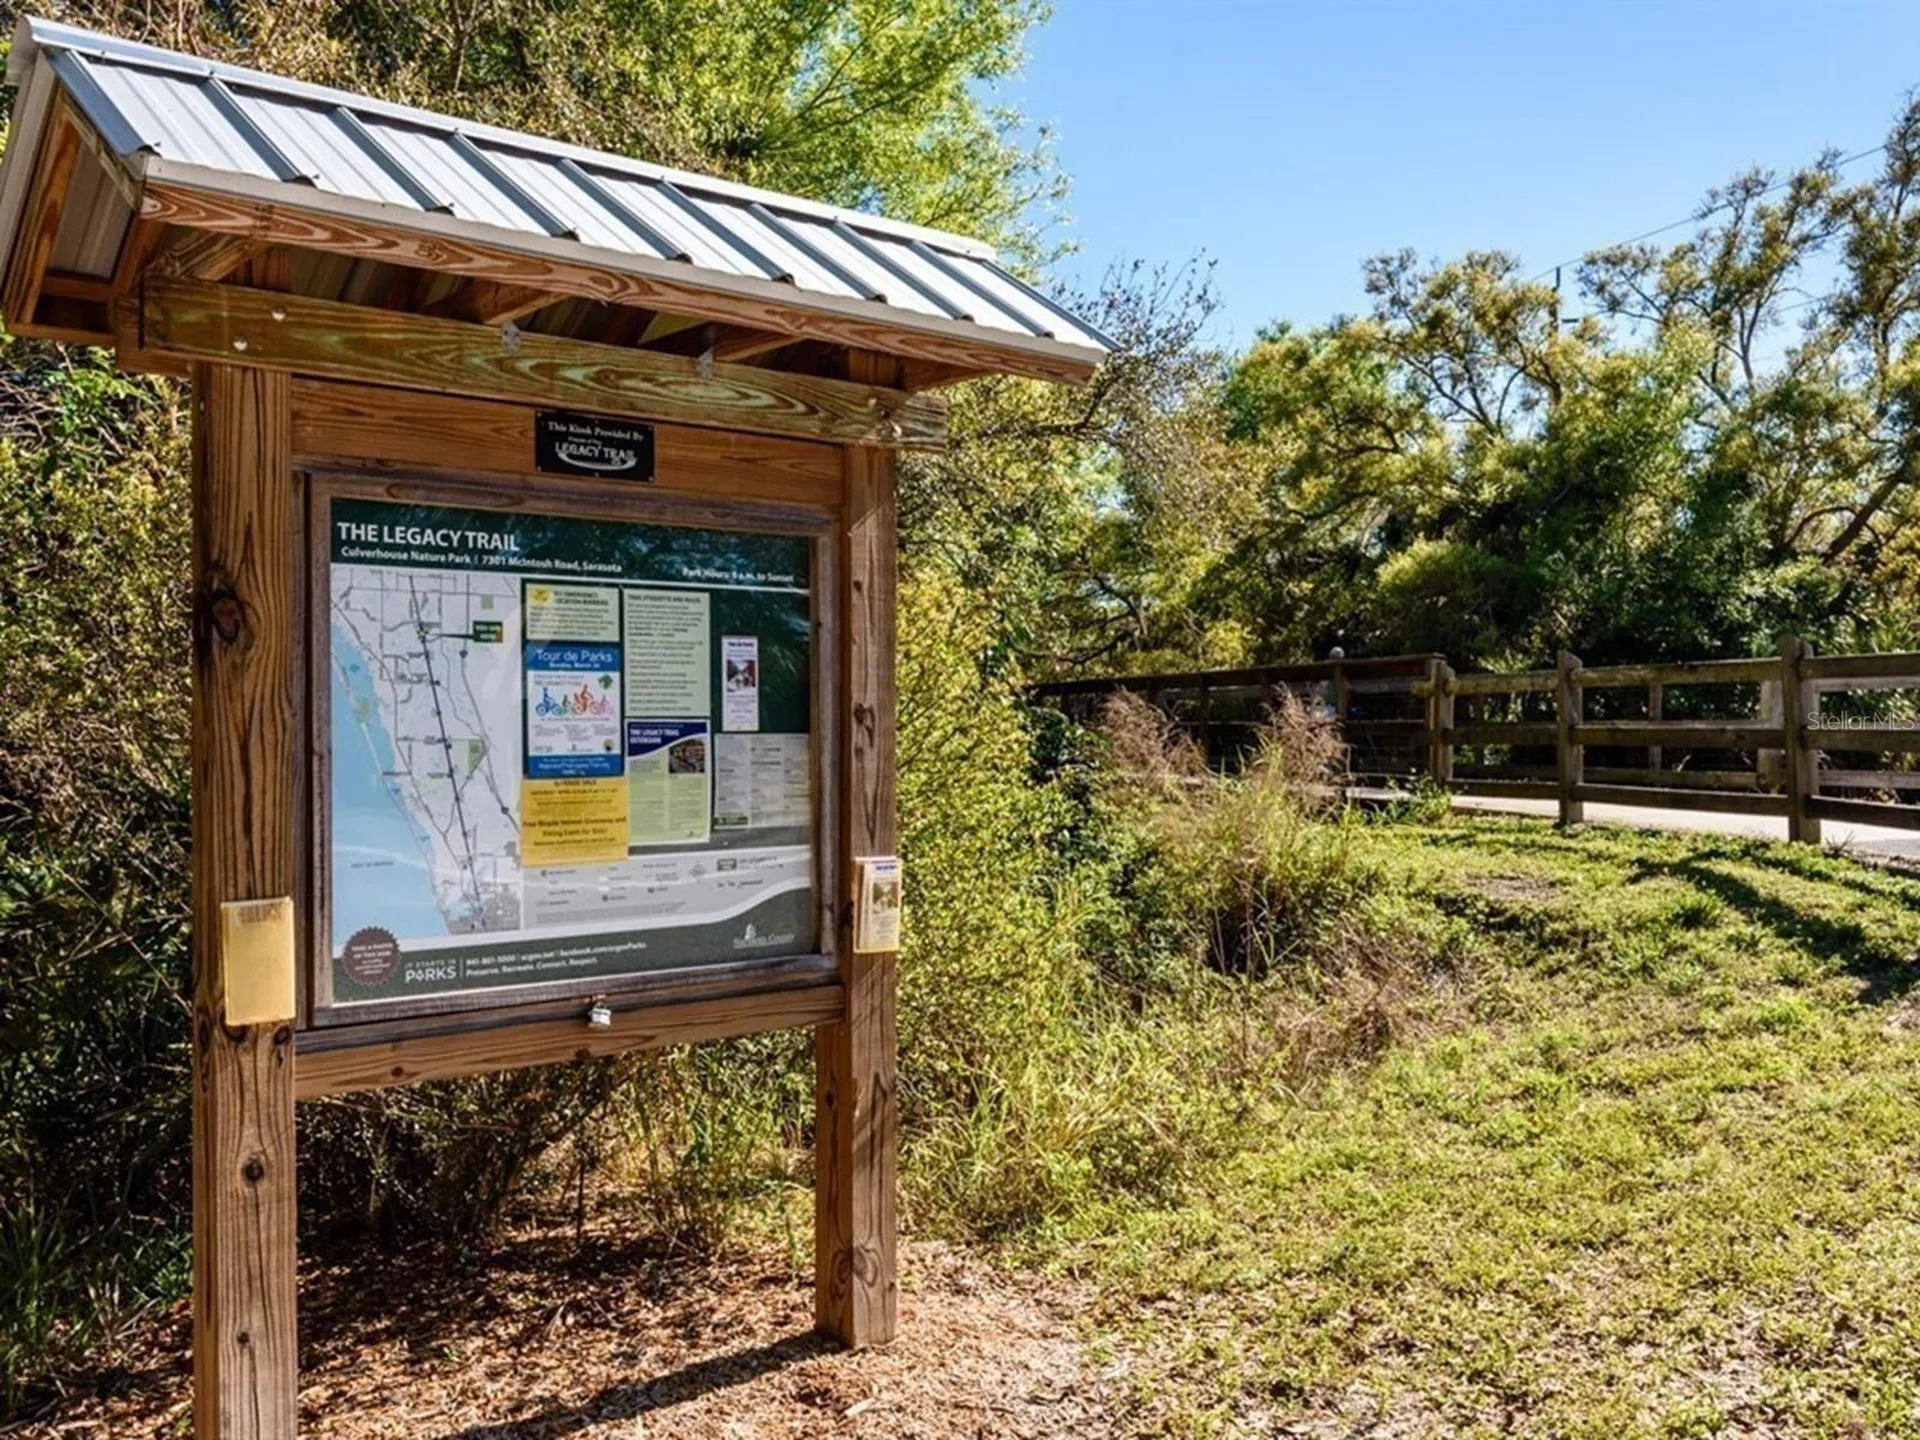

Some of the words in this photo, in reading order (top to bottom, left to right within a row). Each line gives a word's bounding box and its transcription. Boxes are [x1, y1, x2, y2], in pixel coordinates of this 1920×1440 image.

[547, 421, 567, 432] This
[568, 424, 592, 436] Kiosk
[594, 427, 631, 440] Provided
[555, 441, 602, 458] LEGACY
[337, 521, 379, 543] THE
[383, 526, 461, 548] LEGACY
[464, 531, 520, 551] TRAIL
[341, 546, 408, 561] Culverhouse
[410, 551, 446, 563] Nature
[449, 553, 471, 564] Park
[482, 555, 506, 566] 7301
[508, 556, 553, 569] McIntosh
[554, 559, 581, 571] Road,
[582, 561, 622, 573] Sarasota
[536, 649, 561, 662] Tour
[563, 650, 578, 662] de
[581, 650, 613, 662] Parks
[405, 966, 457, 983] PARKS
